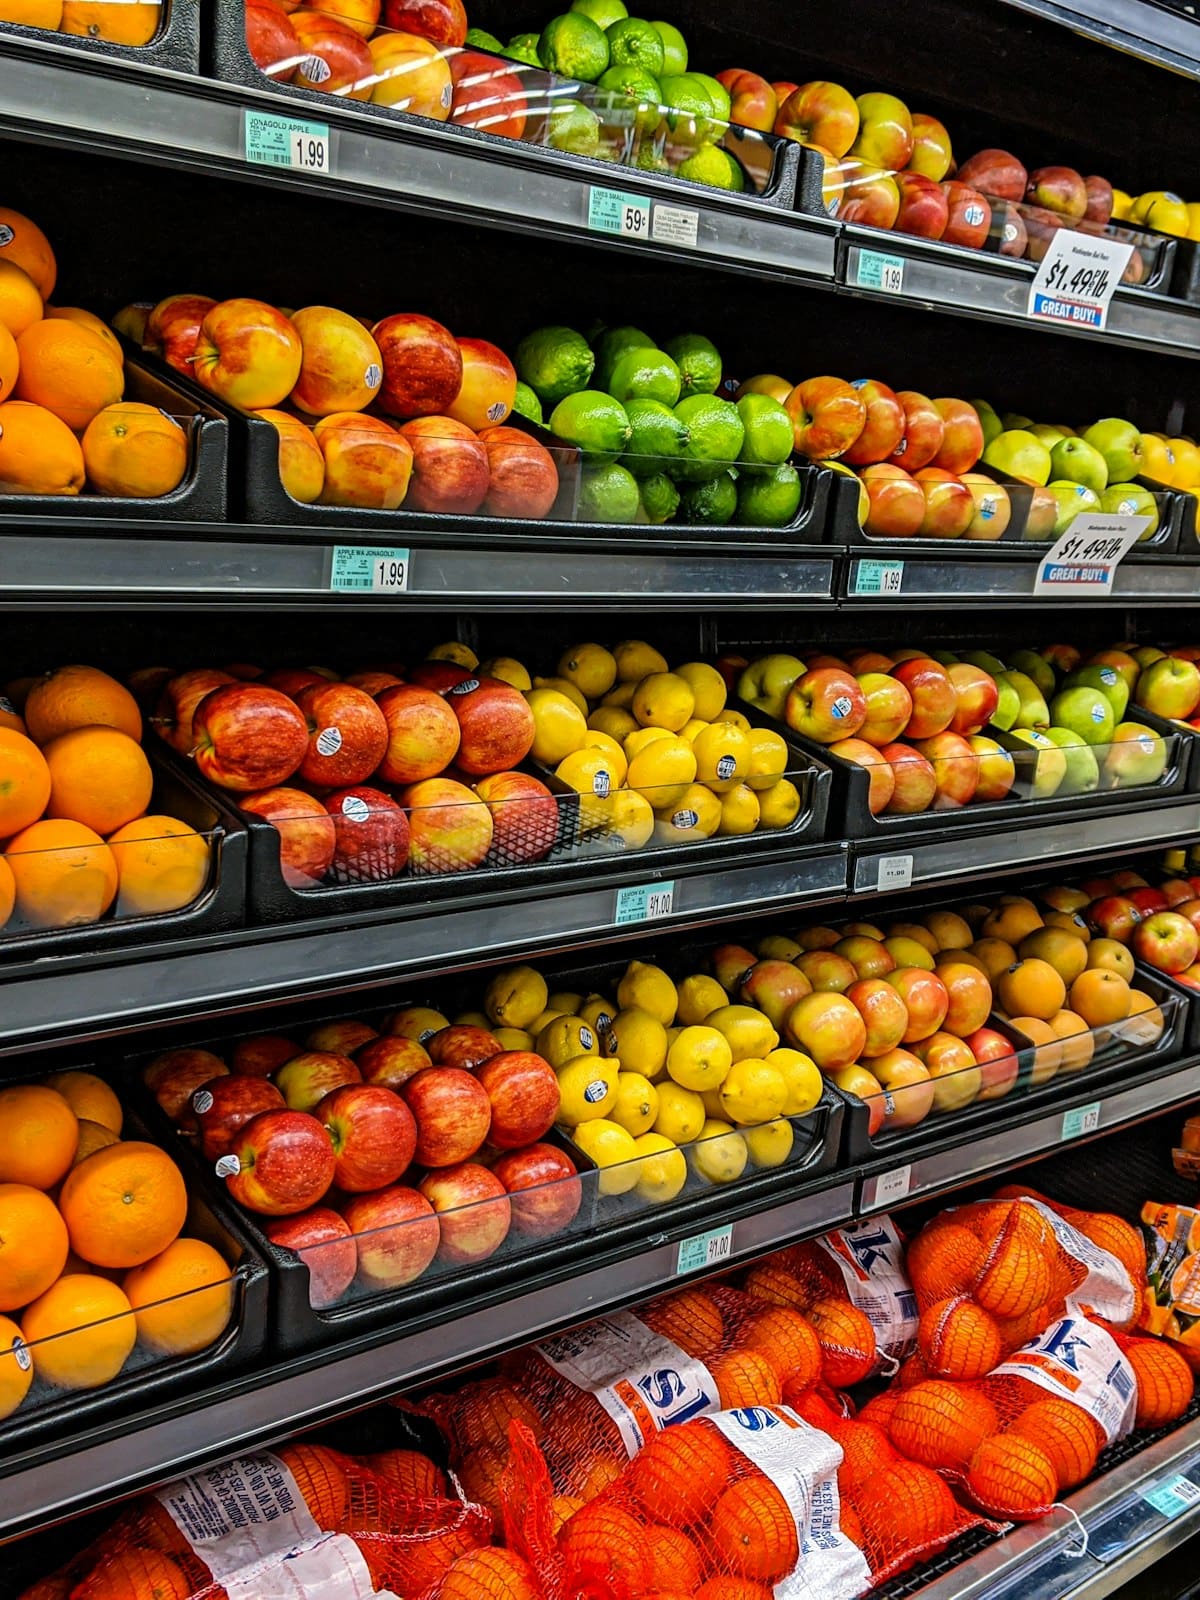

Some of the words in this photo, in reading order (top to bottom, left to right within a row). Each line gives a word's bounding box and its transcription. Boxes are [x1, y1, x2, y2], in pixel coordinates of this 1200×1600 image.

[249, 118, 287, 130] JONAGOLD
[288, 124, 310, 134] APPLE
[297, 138, 324, 168] 1.99
[885, 269, 901, 290] 1.99
[1045, 259, 1093, 295] $1.49
[1041, 300, 1071, 318] GREAT
[1072, 305, 1097, 323] BUY!
[337, 548, 355, 556] APPLE
[1057, 536, 1107, 560] $1.49
[380, 561, 404, 586] 1.99
[885, 571, 900, 590] 1.99
[1049, 567, 1080, 581] GREAT
[1081, 568, 1104, 581] BUY!
[267, 1472, 285, 1490] NET
[822, 1481, 833, 1491] kg
[254, 1491, 272, 1507] WT
[275, 1487, 297, 1514] POIDS
[221, 1494, 248, 1528] PRODUCE
[261, 1503, 281, 1522] NET
[822, 1515, 833, 1529] NET
[811, 1525, 821, 1540] WT
[821, 1530, 843, 1549] POIDS
[815, 1539, 831, 1550] NET
